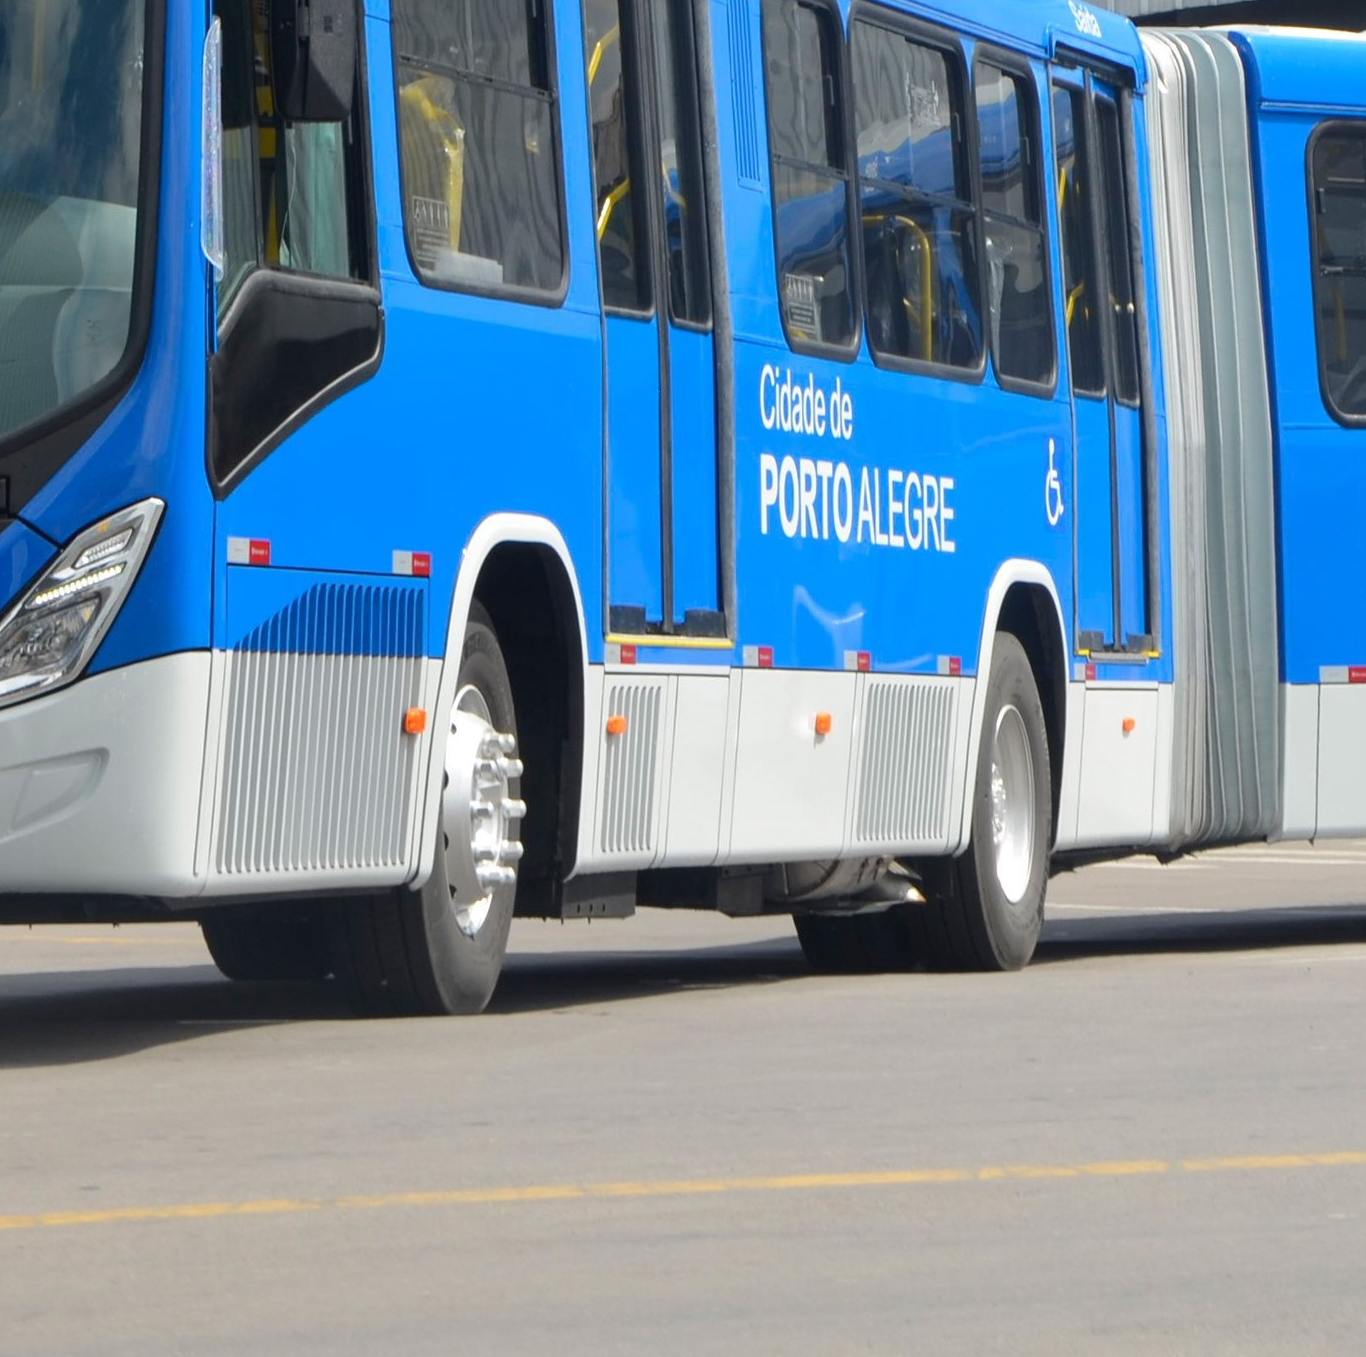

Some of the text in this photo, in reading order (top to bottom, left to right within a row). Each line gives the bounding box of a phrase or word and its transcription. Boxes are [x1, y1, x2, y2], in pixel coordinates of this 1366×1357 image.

[759, 364, 853, 440] Cidade de
[760, 453, 956, 553] PORTO ALEGRE
